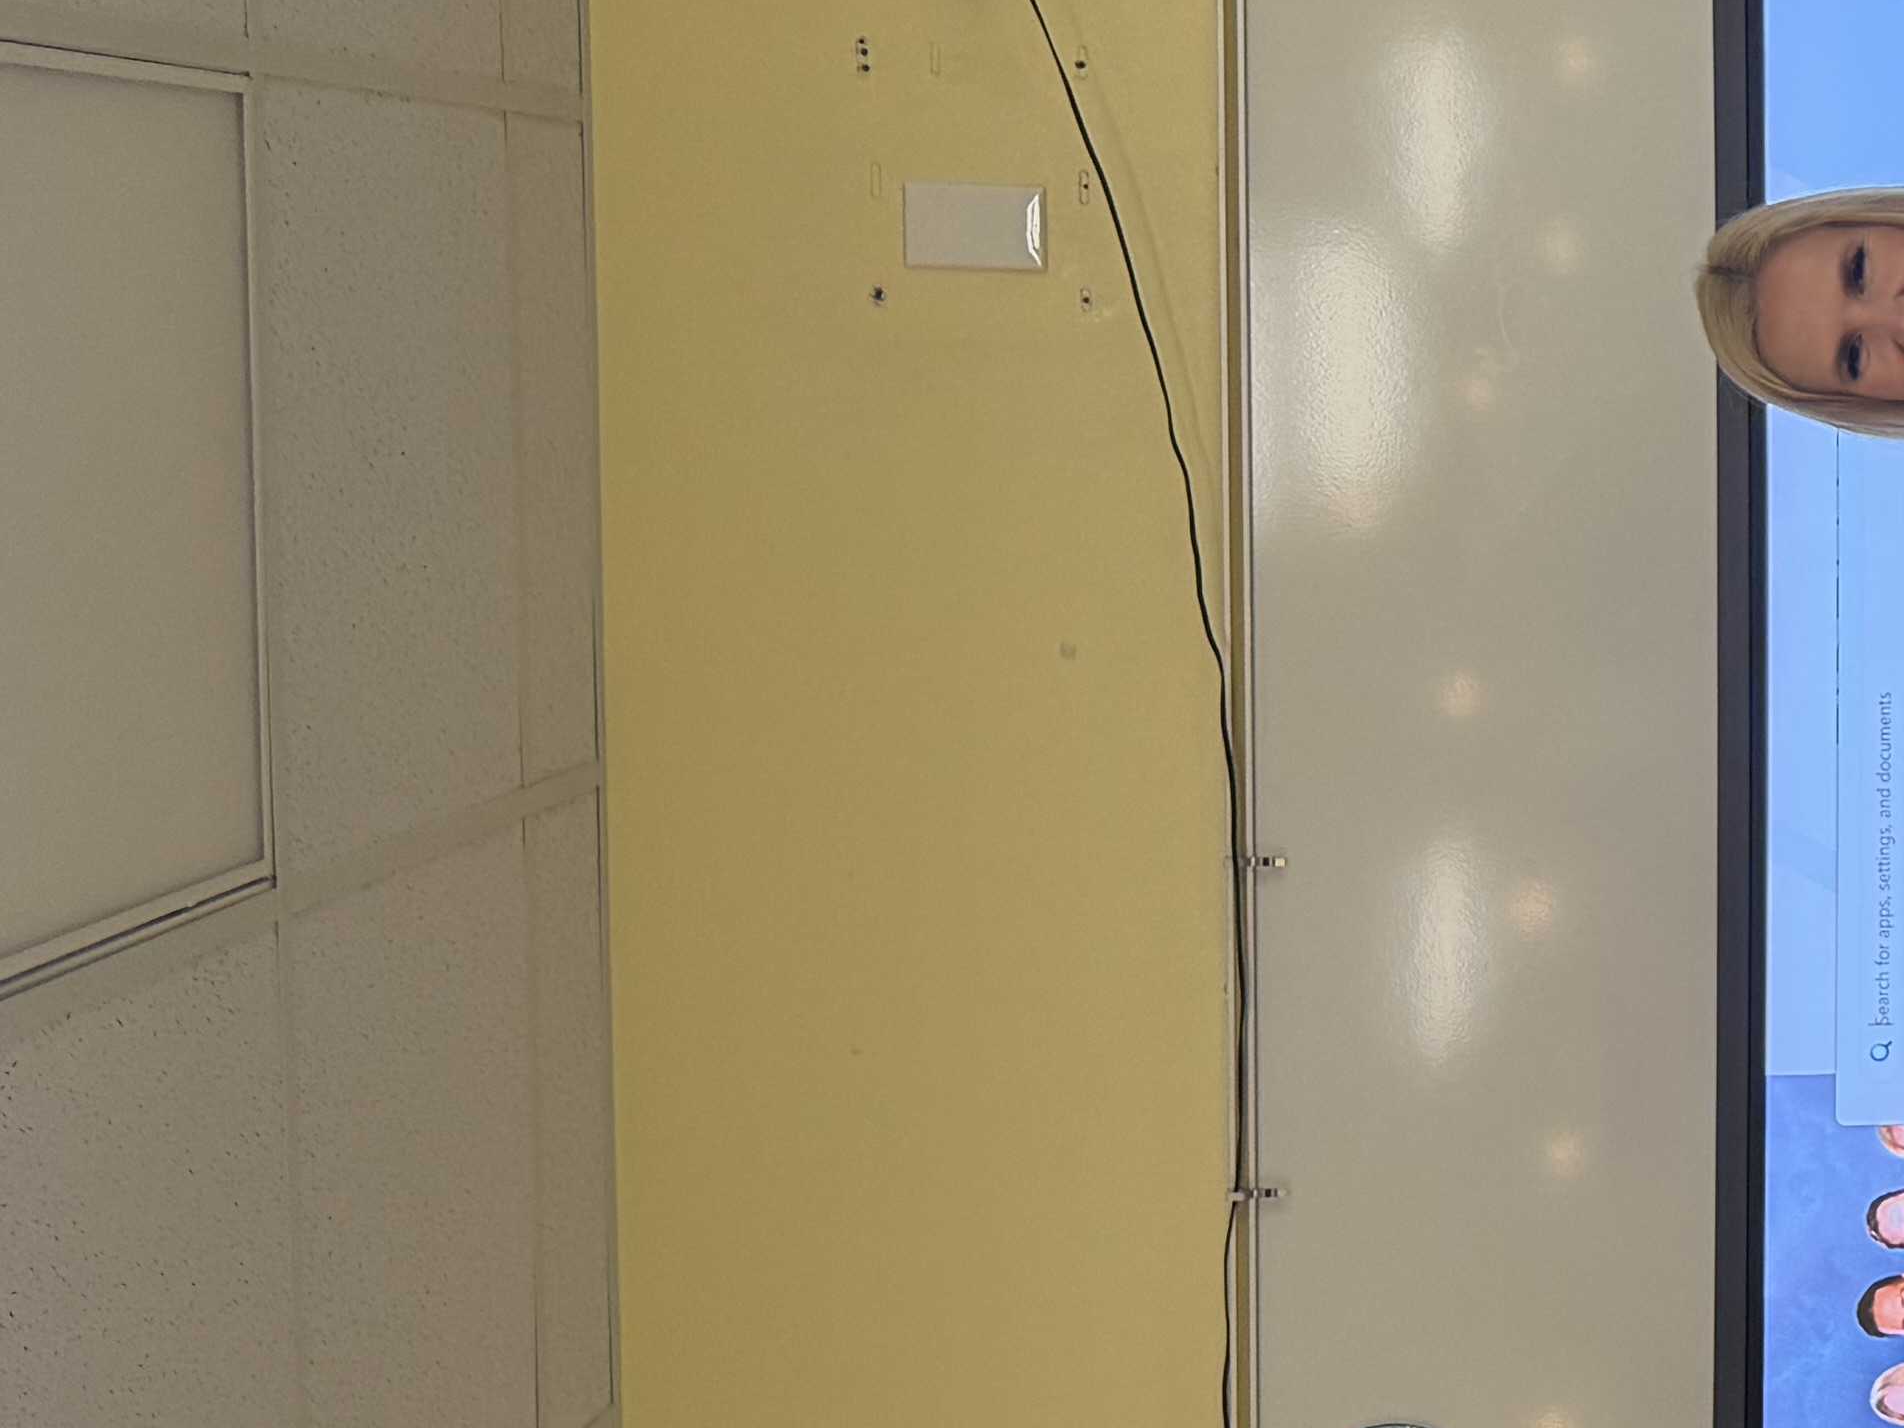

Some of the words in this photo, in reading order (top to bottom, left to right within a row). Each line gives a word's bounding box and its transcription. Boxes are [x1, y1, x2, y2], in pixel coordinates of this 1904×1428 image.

[1876, 692, 1893, 783] documents
[1876, 788, 1892, 818] and
[1875, 824, 1896, 890] settings,
[1877, 895, 1895, 938] apps,
[1875, 944, 1891, 965] for
[1875, 972, 1891, 1026] Search
